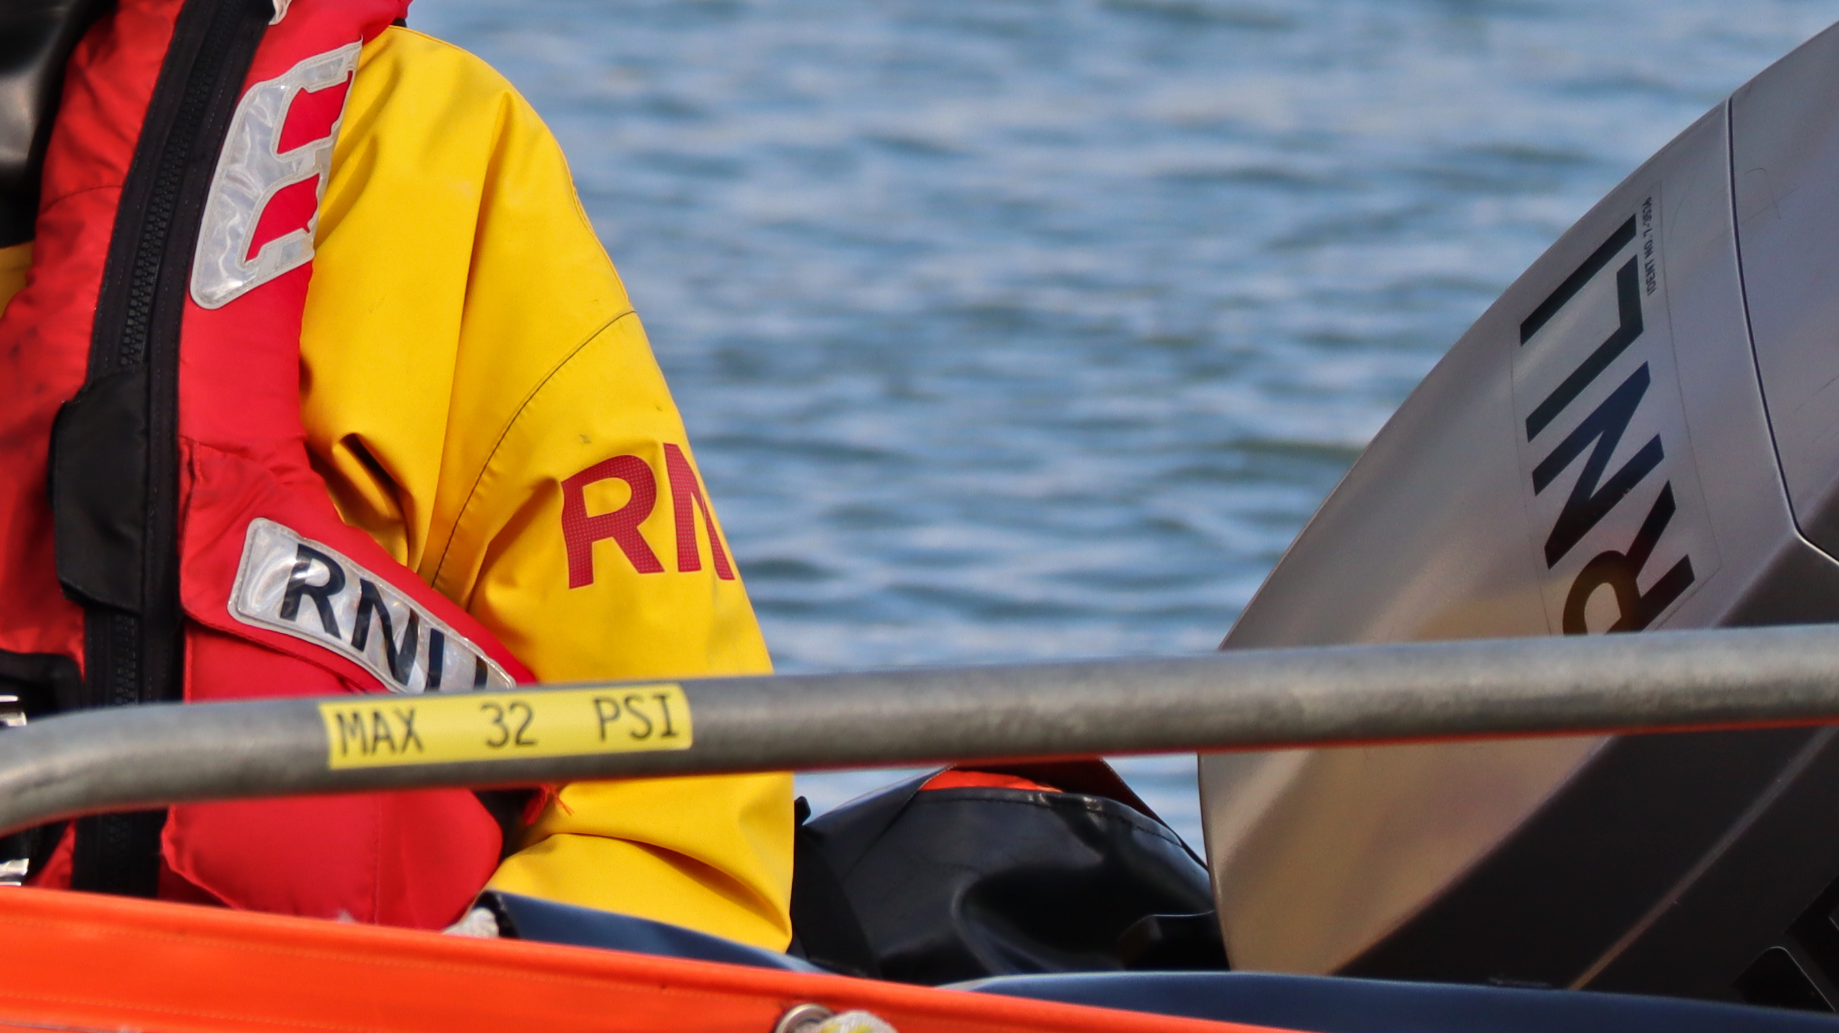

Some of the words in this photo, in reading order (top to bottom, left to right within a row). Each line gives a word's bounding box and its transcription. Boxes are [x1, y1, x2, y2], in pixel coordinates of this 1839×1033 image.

[1520, 213, 1696, 636] RNLI
[335, 706, 424, 758] MAX
[477, 702, 539, 750] 32
[592, 693, 680, 743] PSI
